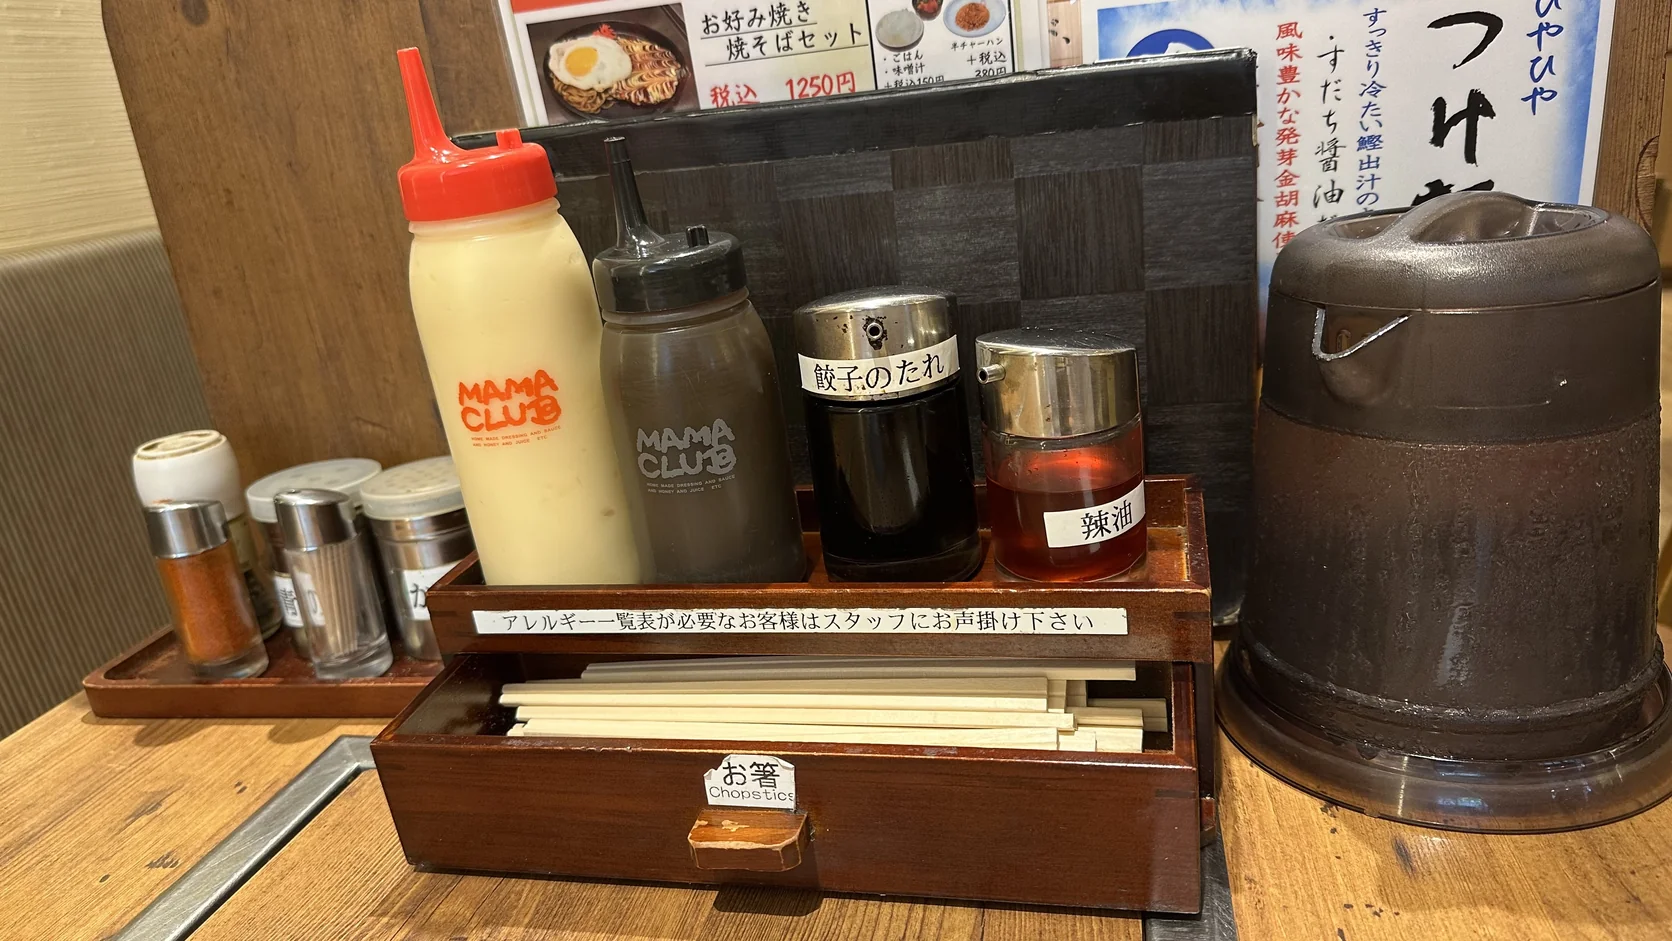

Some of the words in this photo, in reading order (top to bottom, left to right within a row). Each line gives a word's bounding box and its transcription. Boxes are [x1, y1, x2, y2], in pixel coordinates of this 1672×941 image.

[702, 1, 811, 35] お好み焼き
[726, 22, 862, 61] 焼そばセット
[1521, 0, 1564, 116] ひやひや
[709, 83, 760, 108] 税込
[785, 71, 856, 100] 1250円
[1411, 11, 1504, 206] つけ
[1313, 35, 1346, 222] ・すだち醤油
[1356, 8, 1387, 211] すっきり冷たい鰹出汁の
[1272, 21, 1303, 248] 風味豊かな発芽金胡麻使
[458, 369, 559, 406] MAMA
[813, 353, 945, 392] 餃子のたれ
[461, 395, 562, 432] CLUB
[636, 418, 736, 453] MAMA
[637, 444, 737, 479] CLUB
[1080, 499, 1133, 541] 辣油
[502, 610, 1095, 632] アレルギー一覧表が必要なお客様はスタッフにお声掛け下さい
[722, 761, 780, 789] お箸
